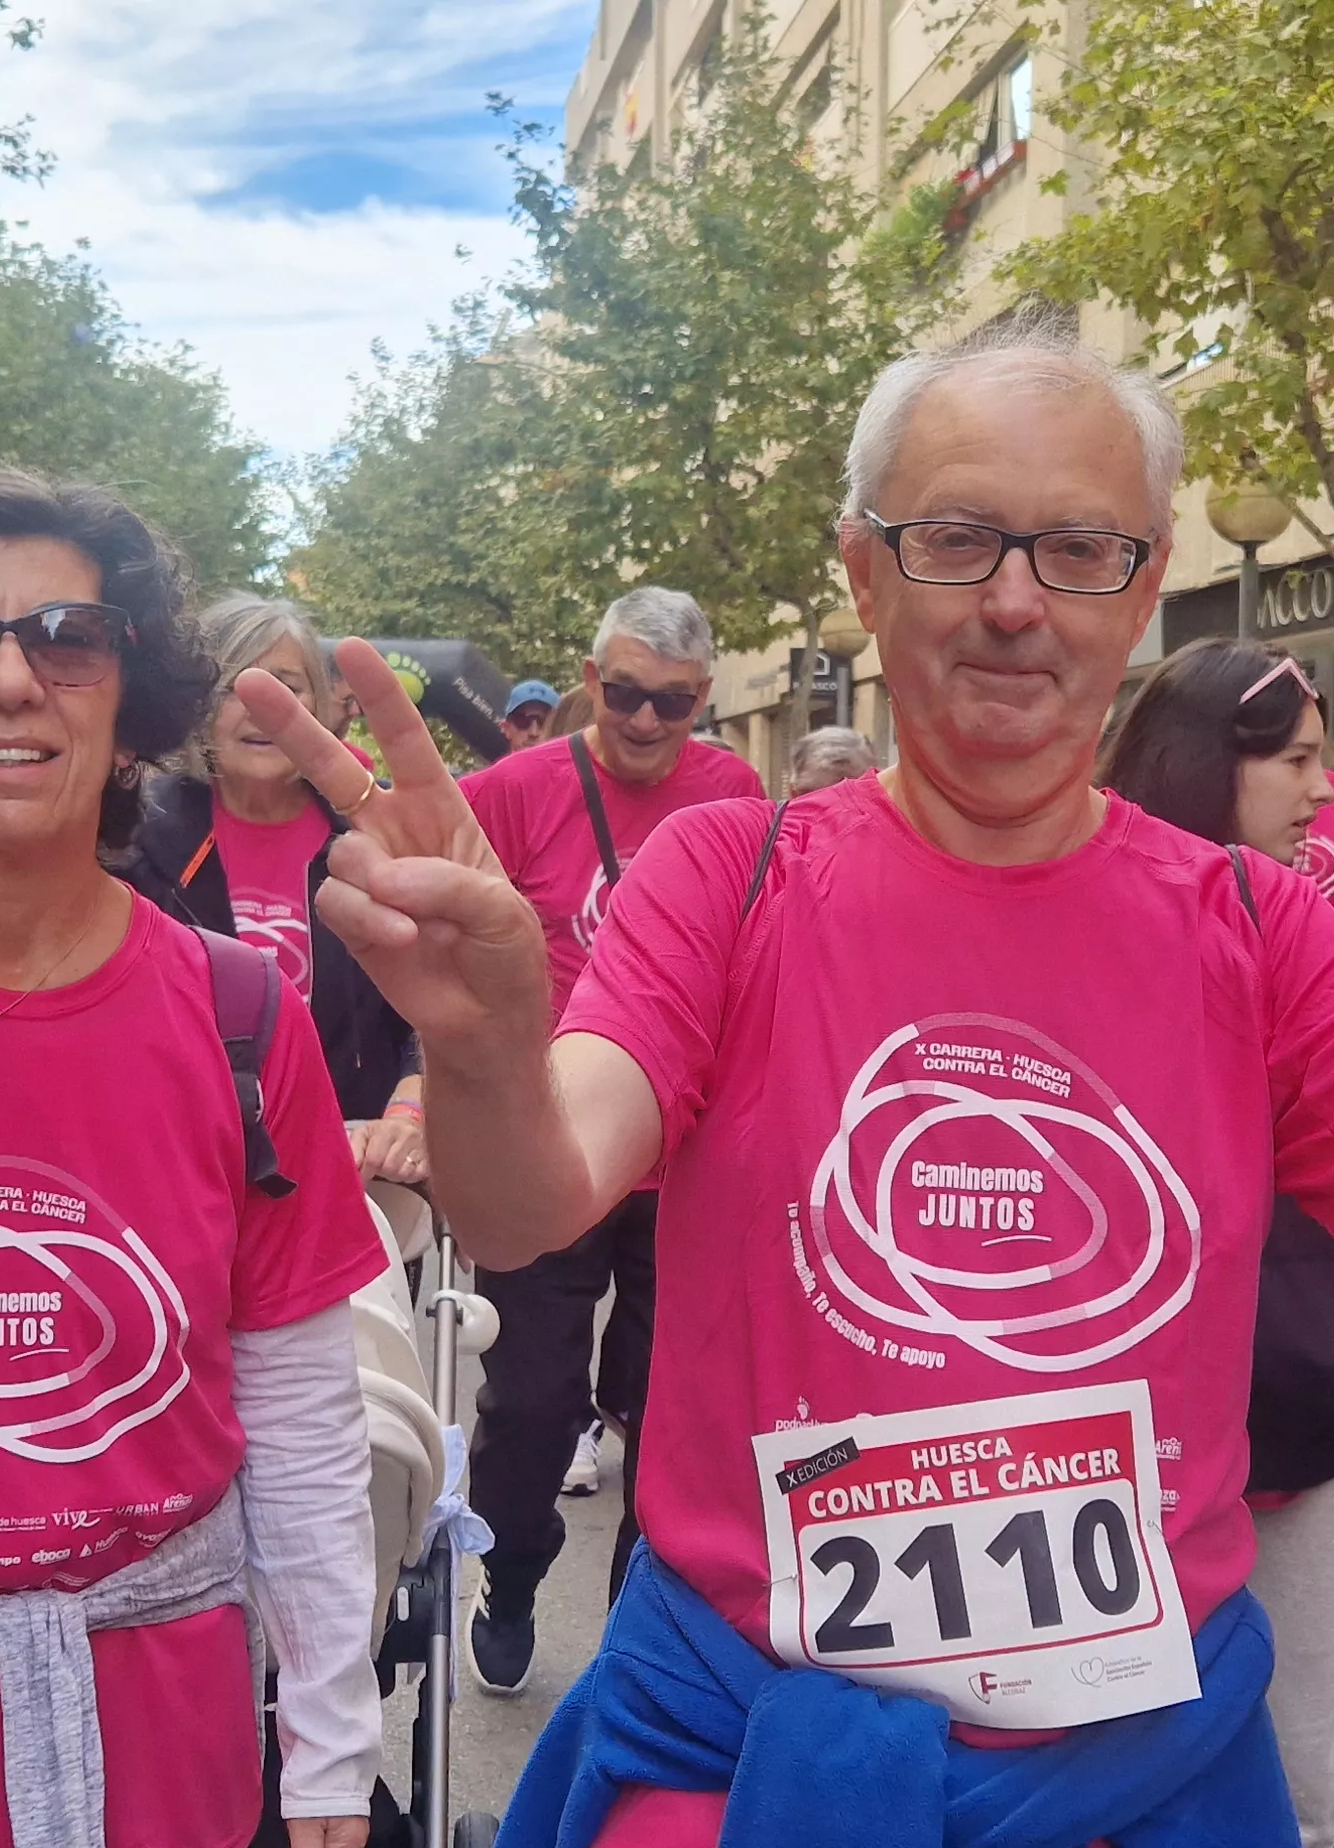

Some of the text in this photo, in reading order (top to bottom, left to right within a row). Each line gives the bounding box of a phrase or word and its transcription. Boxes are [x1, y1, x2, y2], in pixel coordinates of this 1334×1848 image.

[915, 1043, 1071, 1085] X CARRERA HUESCA
[923, 1057, 1071, 1099] CONTRA EL CÁNCER
[911, 1160, 1044, 1194] Caminemos
[12, 1200, 28, 1213] EL
[31, 1202, 86, 1224] CÁNCER
[32, 1190, 87, 1212] HUESCA
[918, 1193, 1035, 1232] JUNTOS
[786, 1200, 947, 1369] Te acompaño, Te escucho, Te apoyo
[786, 1447, 848, 1488] X EDICIÓN
[911, 1436, 1012, 1470] HUESCA
[807, 1447, 1122, 1518] CONTRA EL CÁNCER
[11, 1516, 46, 1526] huesca
[51, 1508, 101, 1530] vive
[810, 1498, 1141, 1654] 2110
